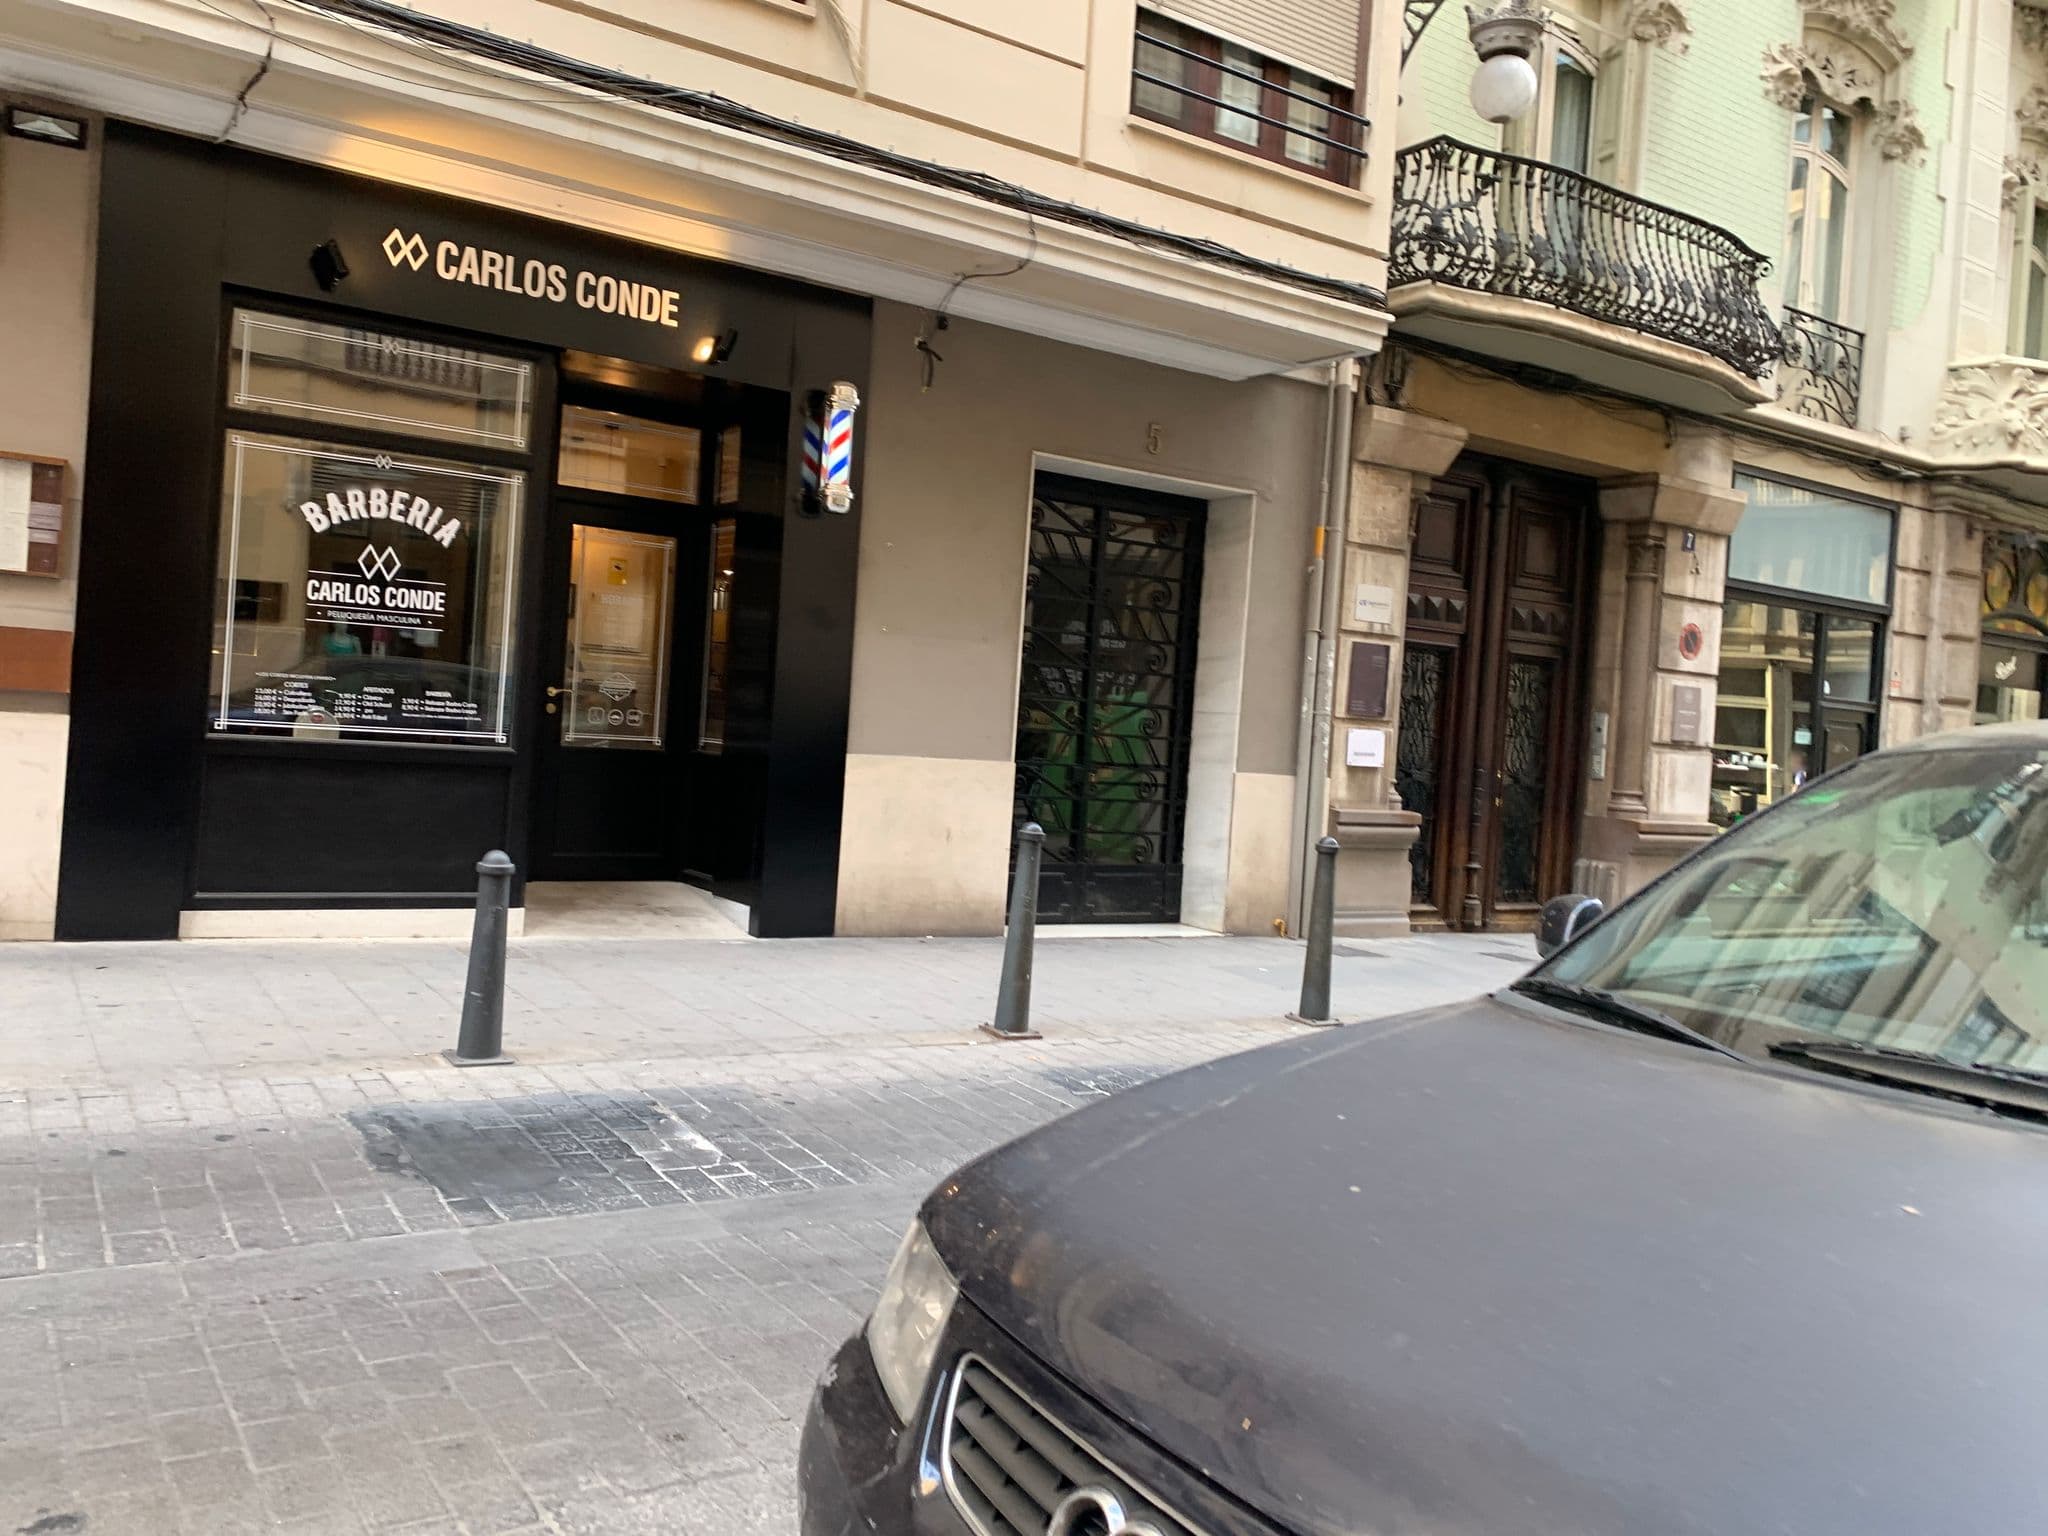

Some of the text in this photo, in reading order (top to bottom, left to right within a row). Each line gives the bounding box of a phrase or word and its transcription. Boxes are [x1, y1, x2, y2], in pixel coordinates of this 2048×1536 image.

[436, 240, 681, 328] CARLOS CONDE
[1147, 422, 1160, 455] 5
[300, 487, 461, 548] BARBERIA
[306, 579, 446, 611] CARLOS CONDE
